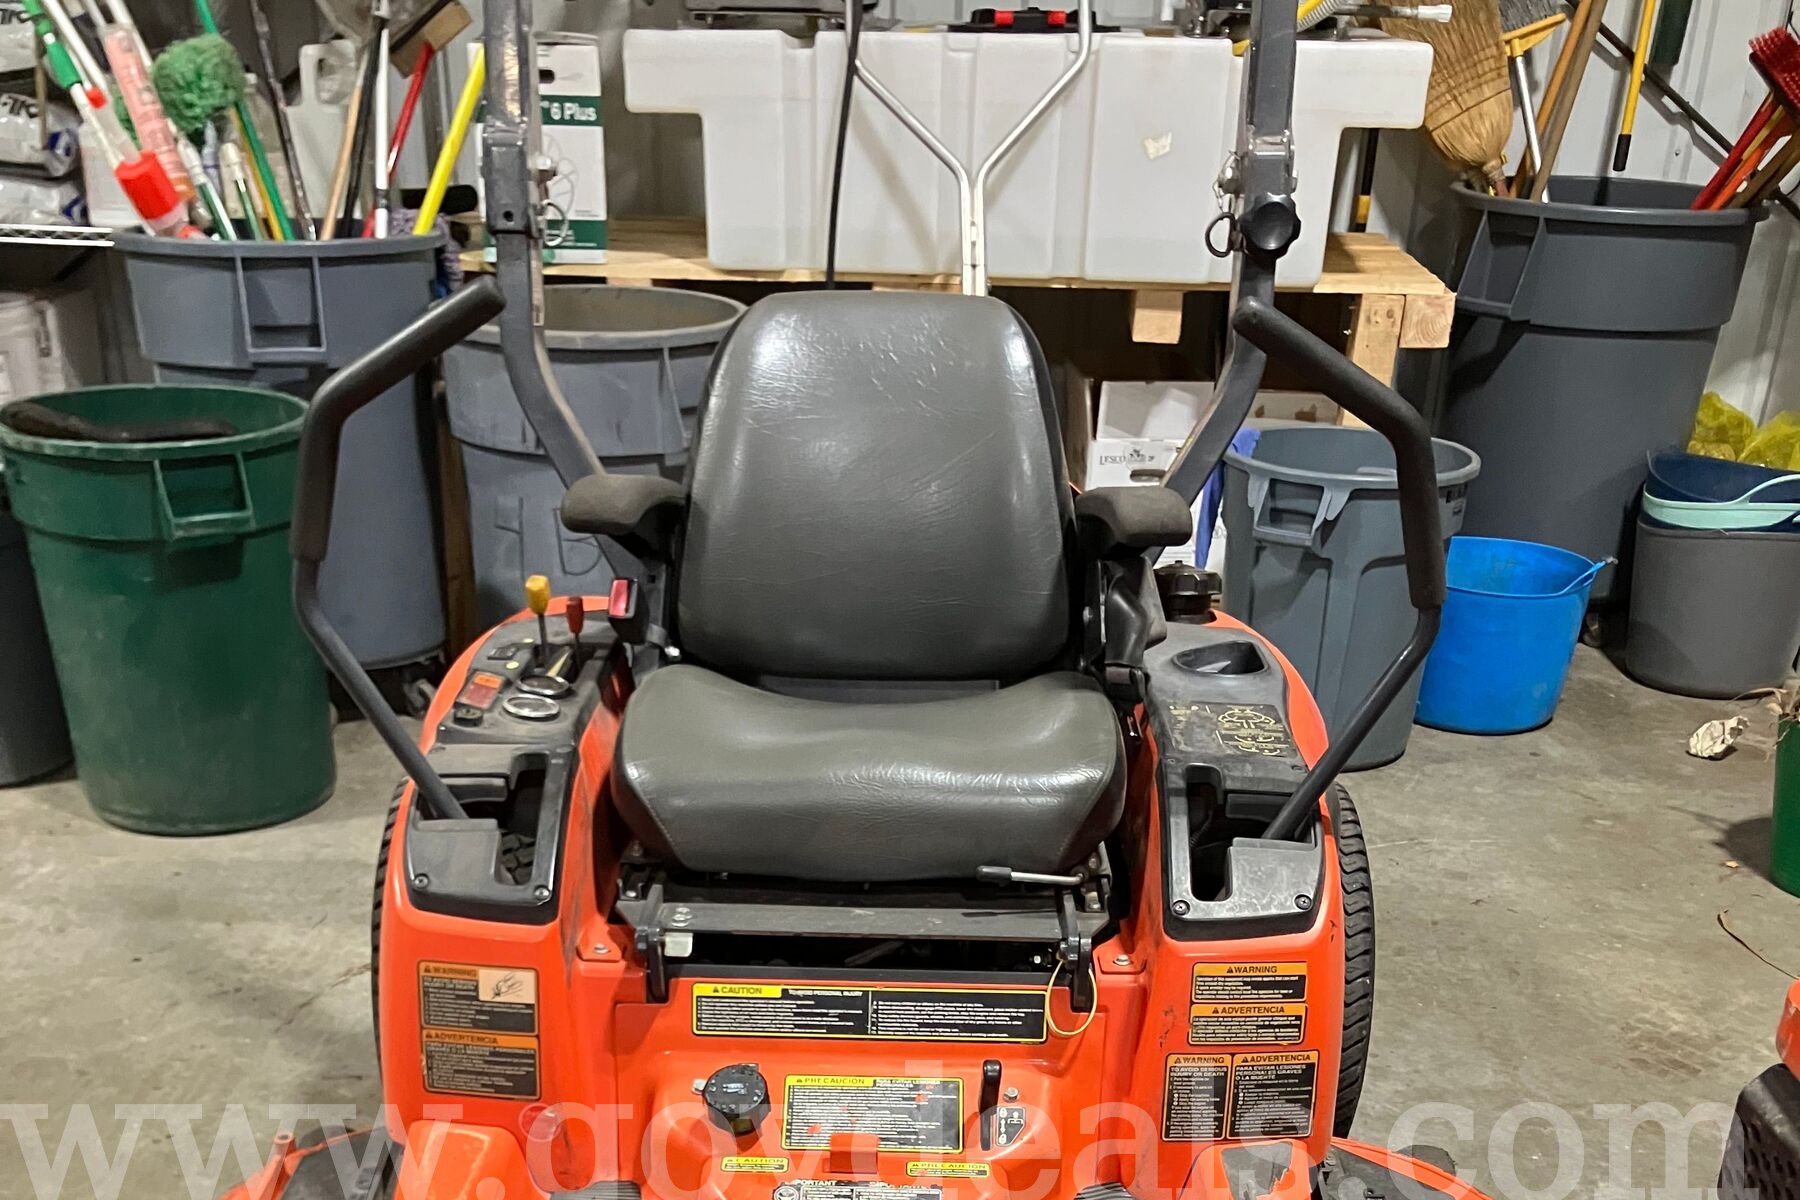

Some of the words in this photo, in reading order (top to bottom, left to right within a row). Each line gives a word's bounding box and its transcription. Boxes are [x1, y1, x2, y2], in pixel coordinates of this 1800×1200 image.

[550, 101, 562, 120] 6
[563, 102, 597, 121] Plus
[1234, 966, 1277, 974] WARNING
[721, 986, 762, 995] CAUTION
[1221, 1006, 1285, 1014] ADVERTENCIA
[434, 1032, 498, 1045] ADVERTENCIA
[1182, 1056, 1225, 1064] WARNING
[1250, 1054, 1311, 1063] ADVERTENCIA
